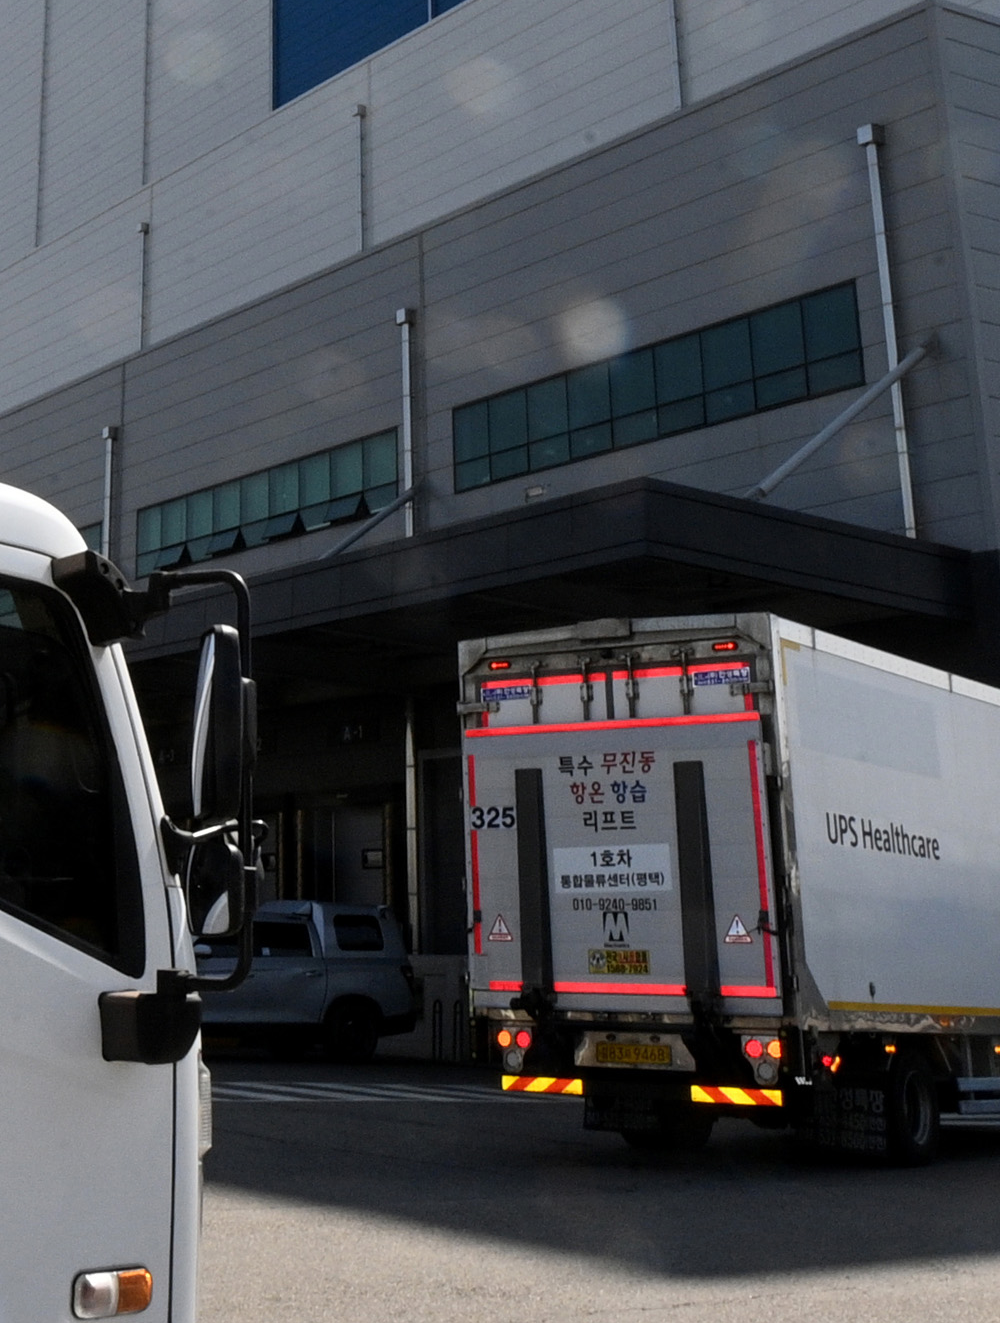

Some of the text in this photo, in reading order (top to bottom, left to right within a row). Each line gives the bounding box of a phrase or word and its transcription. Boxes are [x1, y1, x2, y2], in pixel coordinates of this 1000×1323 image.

[558, 751, 656, 777] 특수 무진동
[570, 780, 647, 805] 항온 항습
[471, 806, 515, 829] 325
[583, 810, 637, 833] 리프트
[826, 812, 941, 861] UPS Healthcare
[590, 849, 633, 868] 1호차
[572, 898, 658, 911] 010-9240-9851
